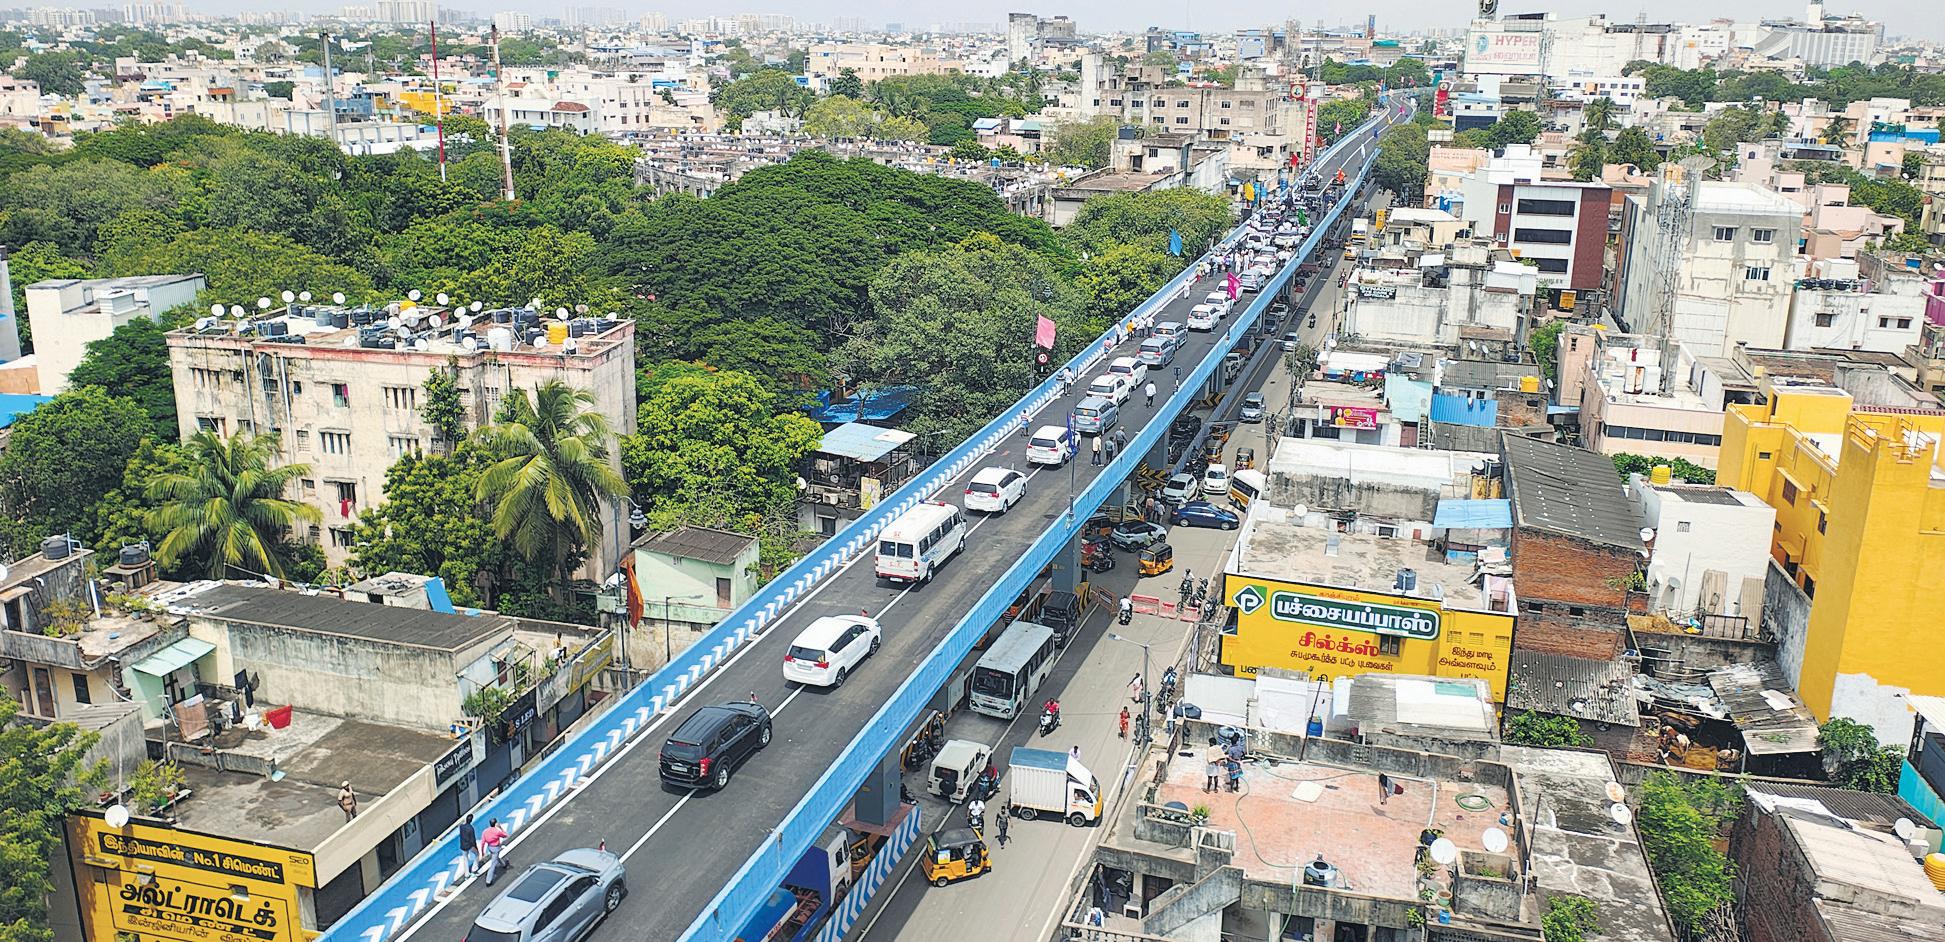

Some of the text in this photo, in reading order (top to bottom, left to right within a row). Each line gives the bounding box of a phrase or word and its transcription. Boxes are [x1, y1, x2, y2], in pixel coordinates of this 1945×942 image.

[1495, 35, 1537, 47] HYPER
[1277, 597, 1433, 633] பச்சையப்பாஸ்
[1299, 631, 1380, 657] சில்க்ஸ்
[103, 834, 185, 861] இந்தியாவின்
[193, 851, 220, 868] No.1
[222, 856, 280, 879] சிமெண்ட்
[120, 880, 277, 928] அல்ட்ராடெக்
